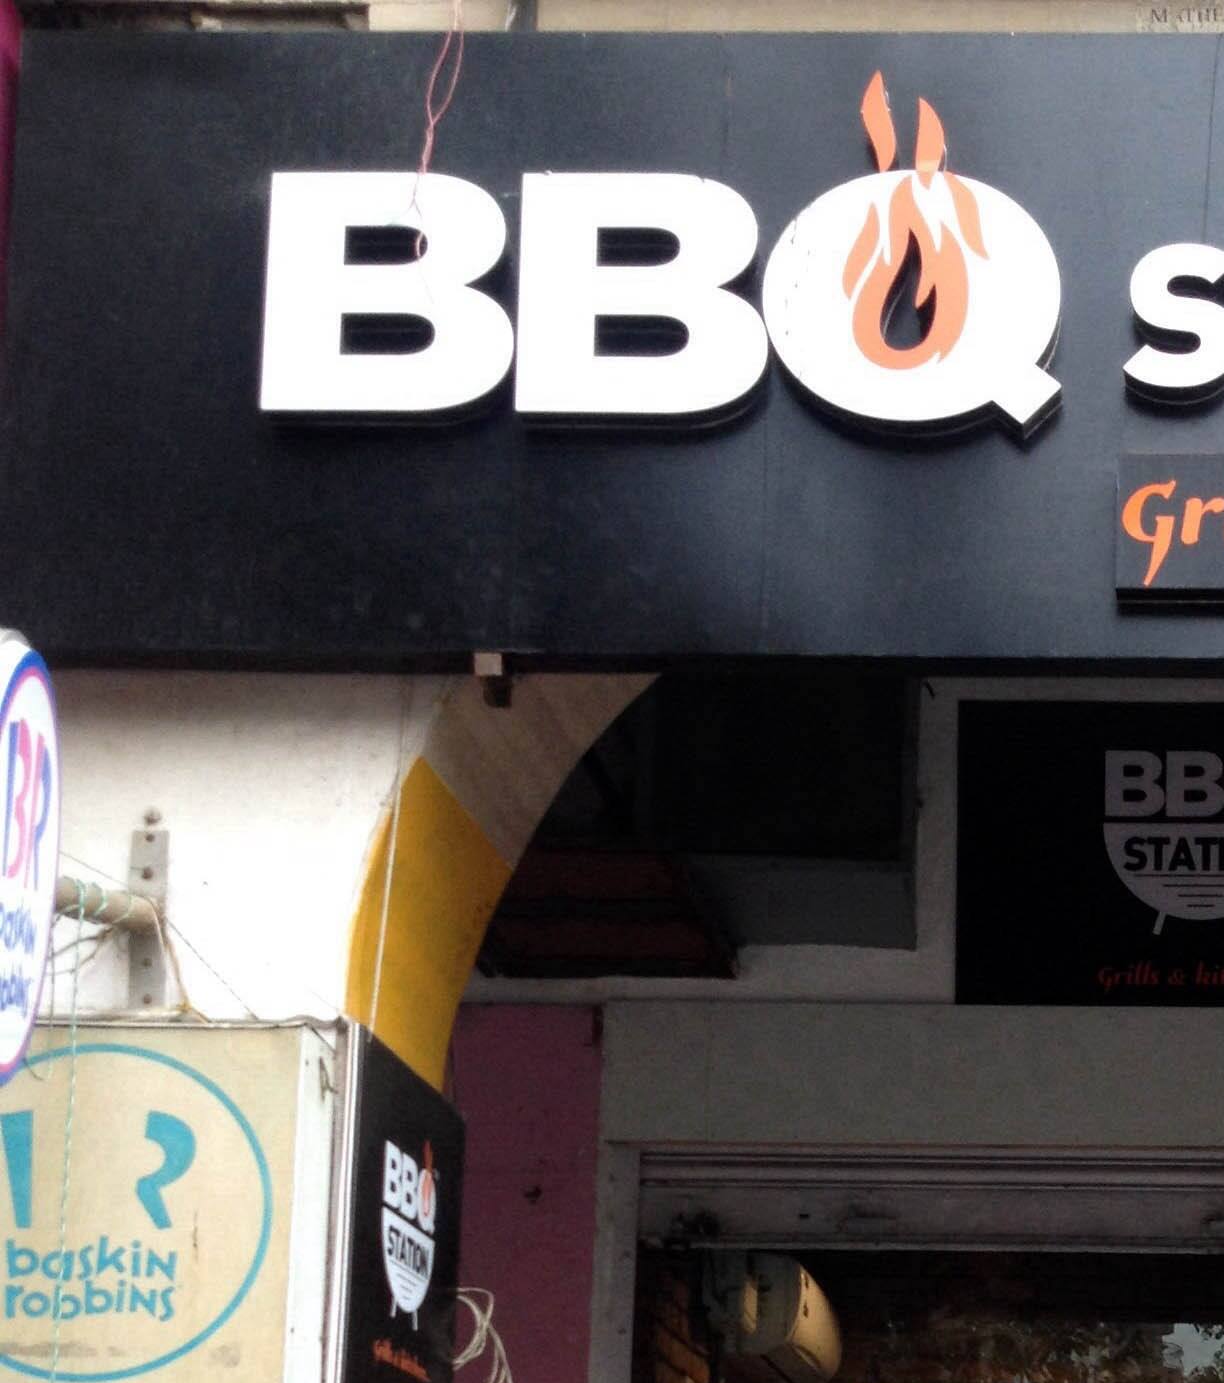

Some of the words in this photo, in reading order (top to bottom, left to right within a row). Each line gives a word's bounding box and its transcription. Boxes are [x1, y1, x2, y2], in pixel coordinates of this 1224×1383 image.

[259, 168, 1063, 426] BBQ
[1098, 960, 1159, 992] Grills
[384, 1139, 436, 1234] BBQ
[388, 1225, 430, 1277] STATION
